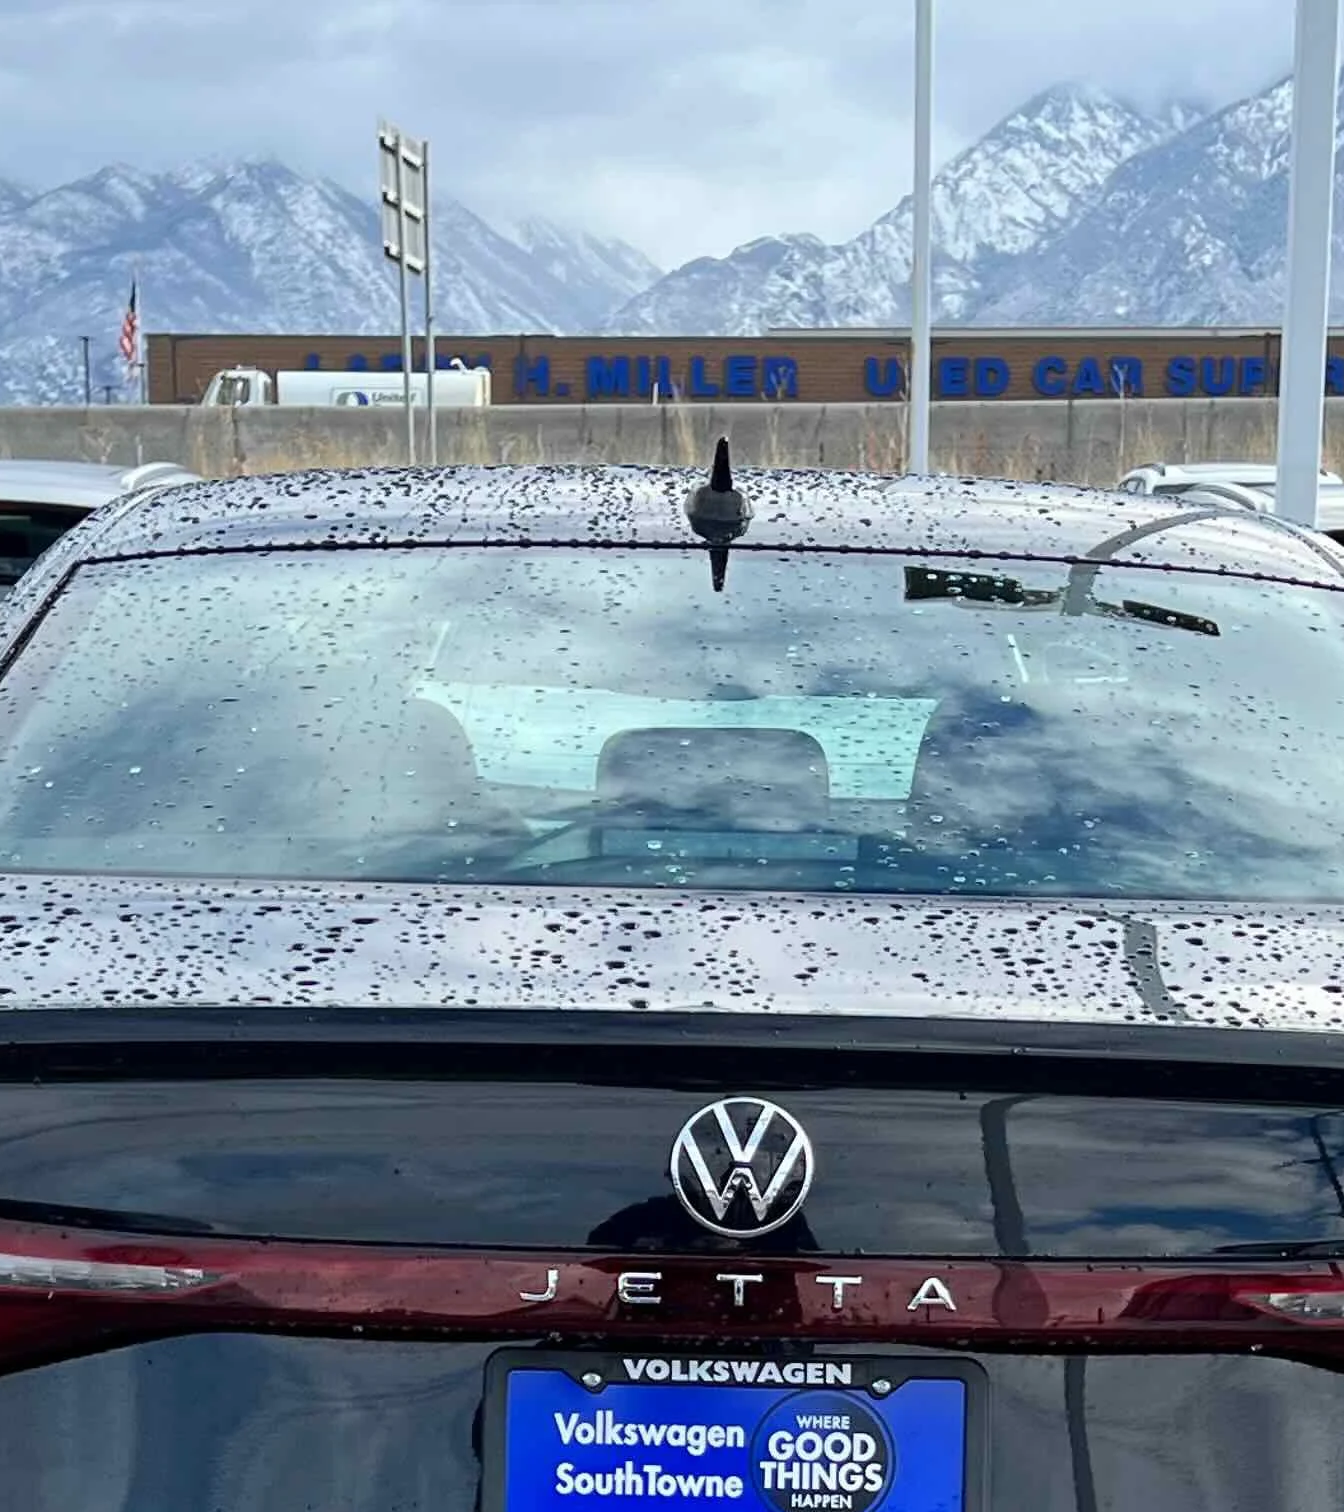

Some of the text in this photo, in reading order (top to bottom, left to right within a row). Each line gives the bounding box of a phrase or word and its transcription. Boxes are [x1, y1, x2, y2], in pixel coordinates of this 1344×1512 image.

[515, 355, 570, 396] H.
[586, 355, 798, 397] MILLER
[865, 356, 1009, 397] UED
[1032, 356, 1143, 397] CAR
[519, 1269, 957, 1311] JETTA
[622, 1358, 852, 1385] VOLKSWAGEN
[554, 1410, 745, 1456] Volkswagen
[795, 1414, 851, 1431] WHERE
[767, 1431, 877, 1462] GOOD
[554, 1460, 744, 1498] SouthTowne
[759, 1460, 884, 1492] THINGS
[790, 1493, 853, 1509] HAPPEN
